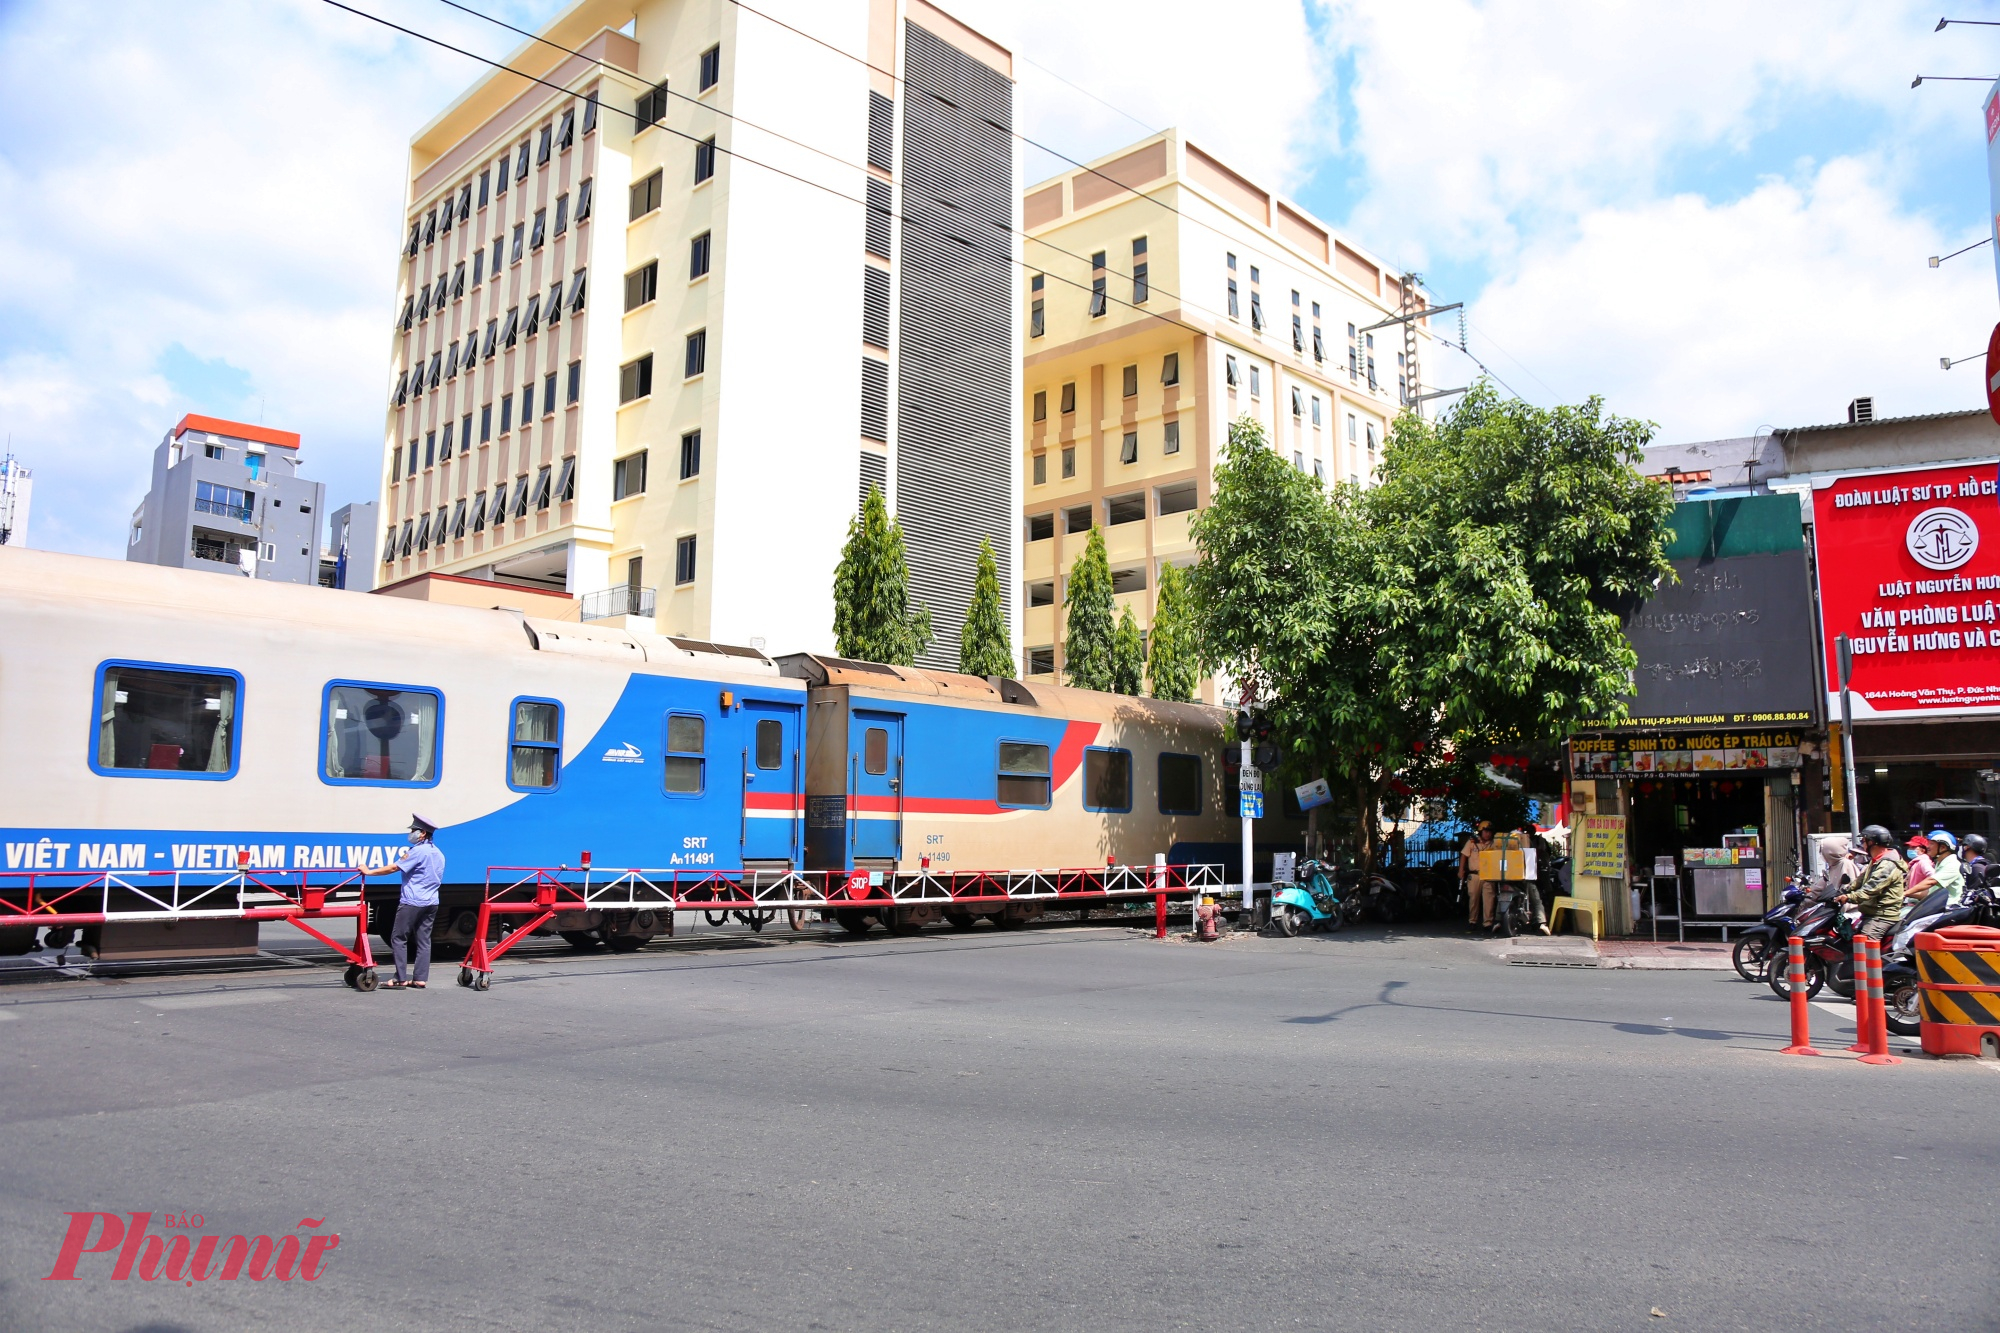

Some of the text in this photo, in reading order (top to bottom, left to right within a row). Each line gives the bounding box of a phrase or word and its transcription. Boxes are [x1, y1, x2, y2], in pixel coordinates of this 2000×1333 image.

[1835, 489, 1872, 508] ĐOÀN
[1874, 486, 1909, 506] LUẬT
[1912, 484, 1932, 501] SƯ
[1934, 484, 1956, 499] TP.
[1959, 475, 1979, 497] HỒ
[1879, 580, 1912, 597] LUẬT
[1915, 573, 1972, 594] NGUYỄN
[1861, 607, 1896, 628] VĂN
[1899, 604, 1958, 626] PHÒNG
[1913, 631, 1960, 651] HƯNG
[1963, 627, 1987, 648] VÀ
[1619, 716, 1638, 726] VĂN
[1693, 714, 1725, 725] NHUẬN
[1733, 714, 1746, 722] ĐT
[1752, 712, 1810, 722] 0906.88.80.84
[1572, 739, 1616, 752] COFFEE
[1628, 738, 1658, 751] SINH
[1686, 733, 1721, 749] NƯỚC
[1723, 733, 1740, 748] ÉP
[1742, 732, 1772, 747] TRÁI
[1774, 731, 1800, 747] CÂY
[683, 836, 708, 849] SRT
[926, 834, 944, 844] SRT
[78, 843, 147, 869] NAM
[171, 844, 286, 869] VIETNAM
[851, 877, 868, 890] STOP
